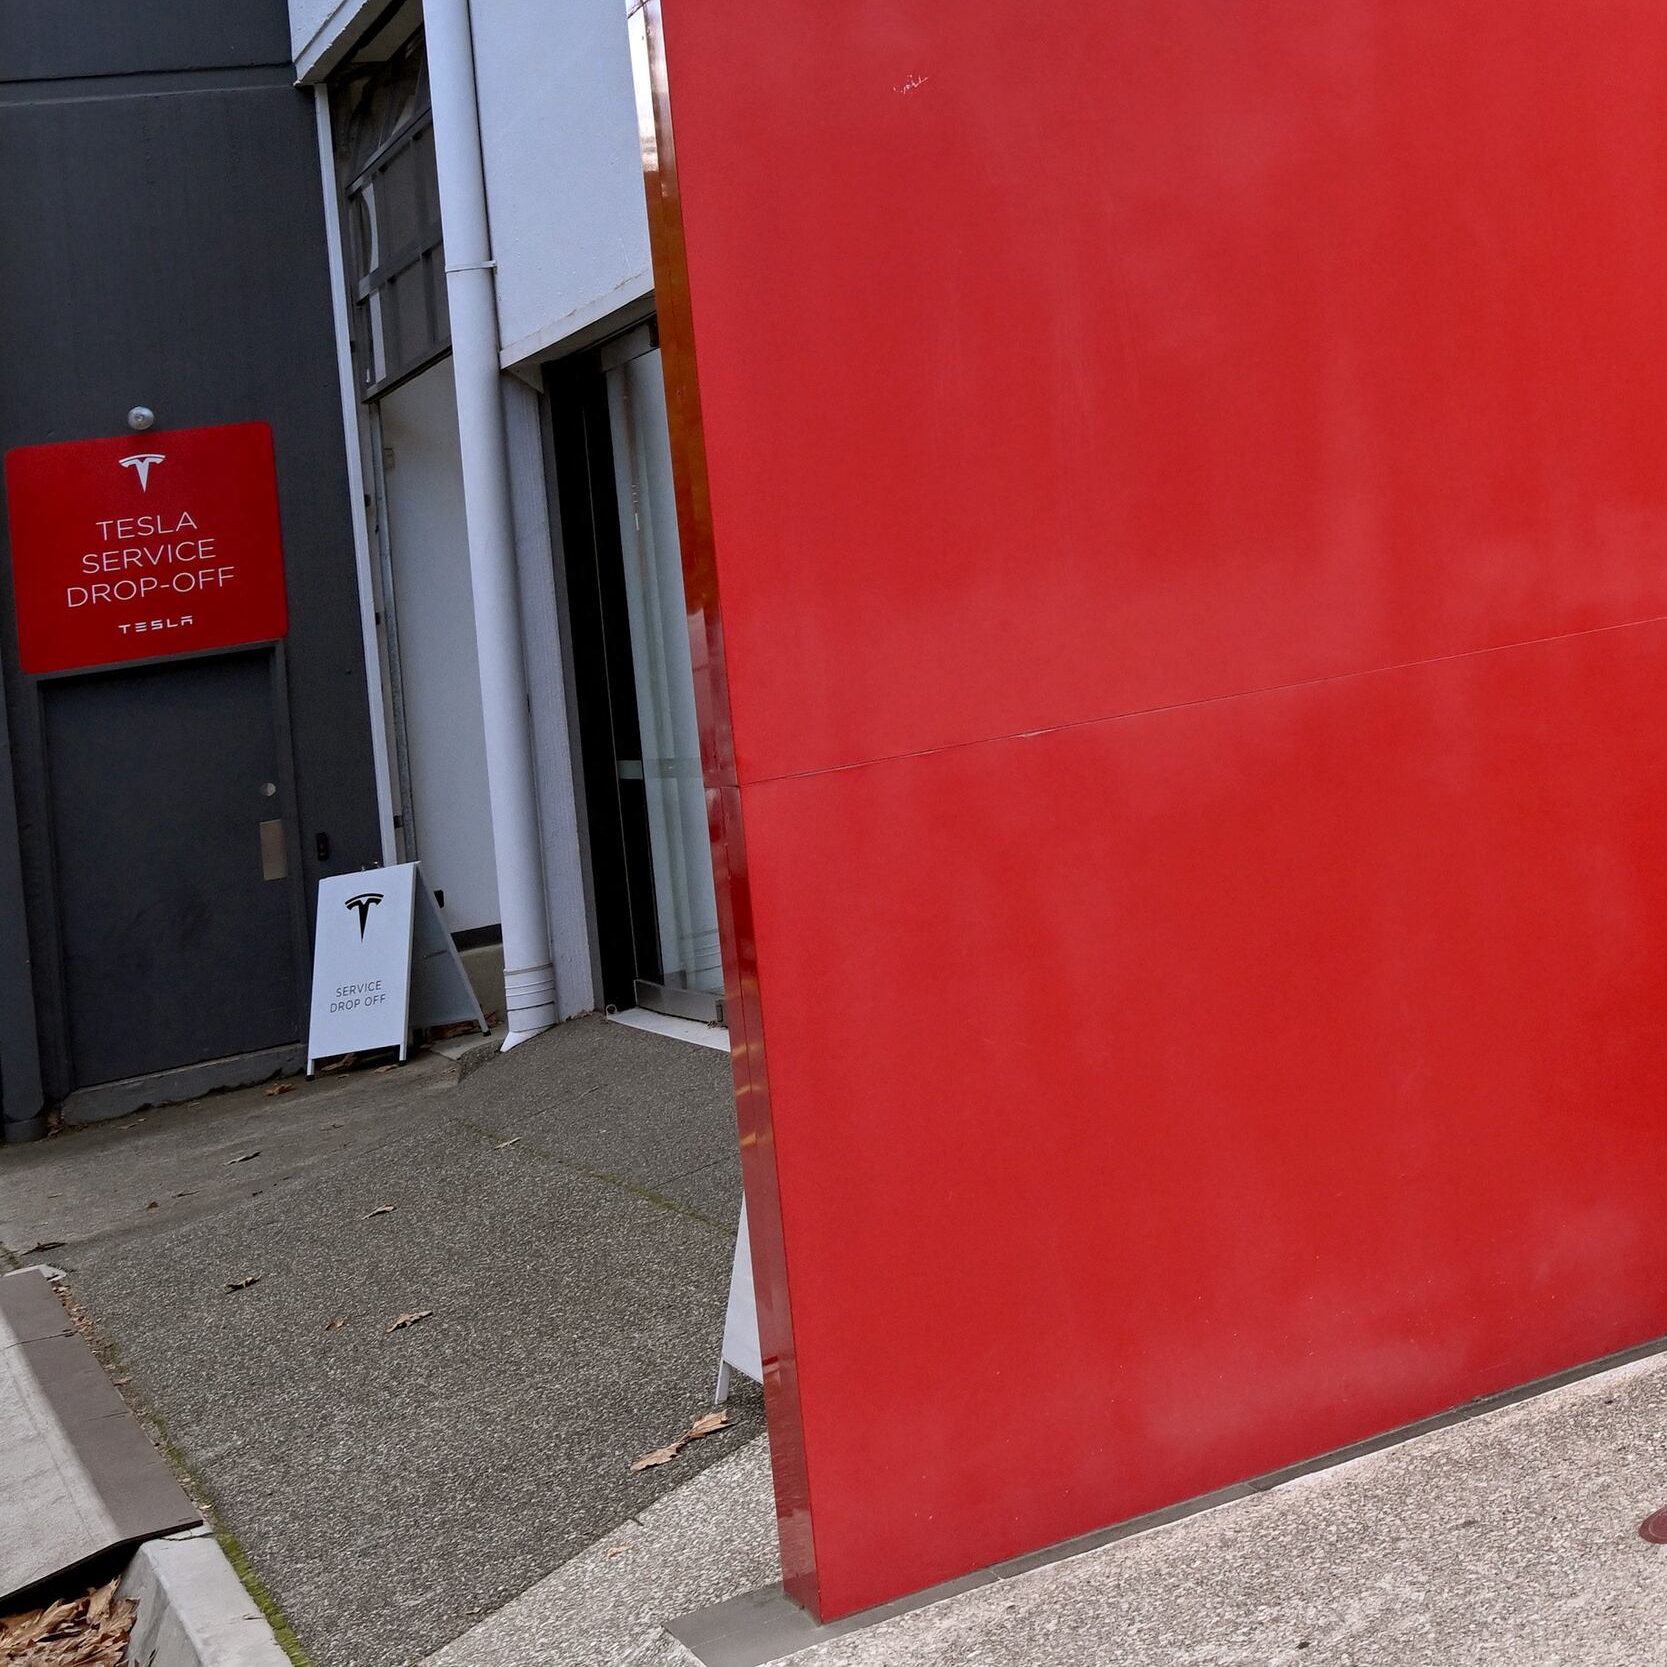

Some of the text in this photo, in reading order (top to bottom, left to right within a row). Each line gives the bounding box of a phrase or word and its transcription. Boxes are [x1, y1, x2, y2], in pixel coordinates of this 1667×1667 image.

[95, 511, 197, 541] TESLA
[82, 538, 216, 574] SERVICE
[66, 566, 235, 608] DROP-OFF
[118, 615, 193, 634] TESLA
[336, 980, 382, 998] SERVICE
[330, 994, 386, 1013] DROP OFF
